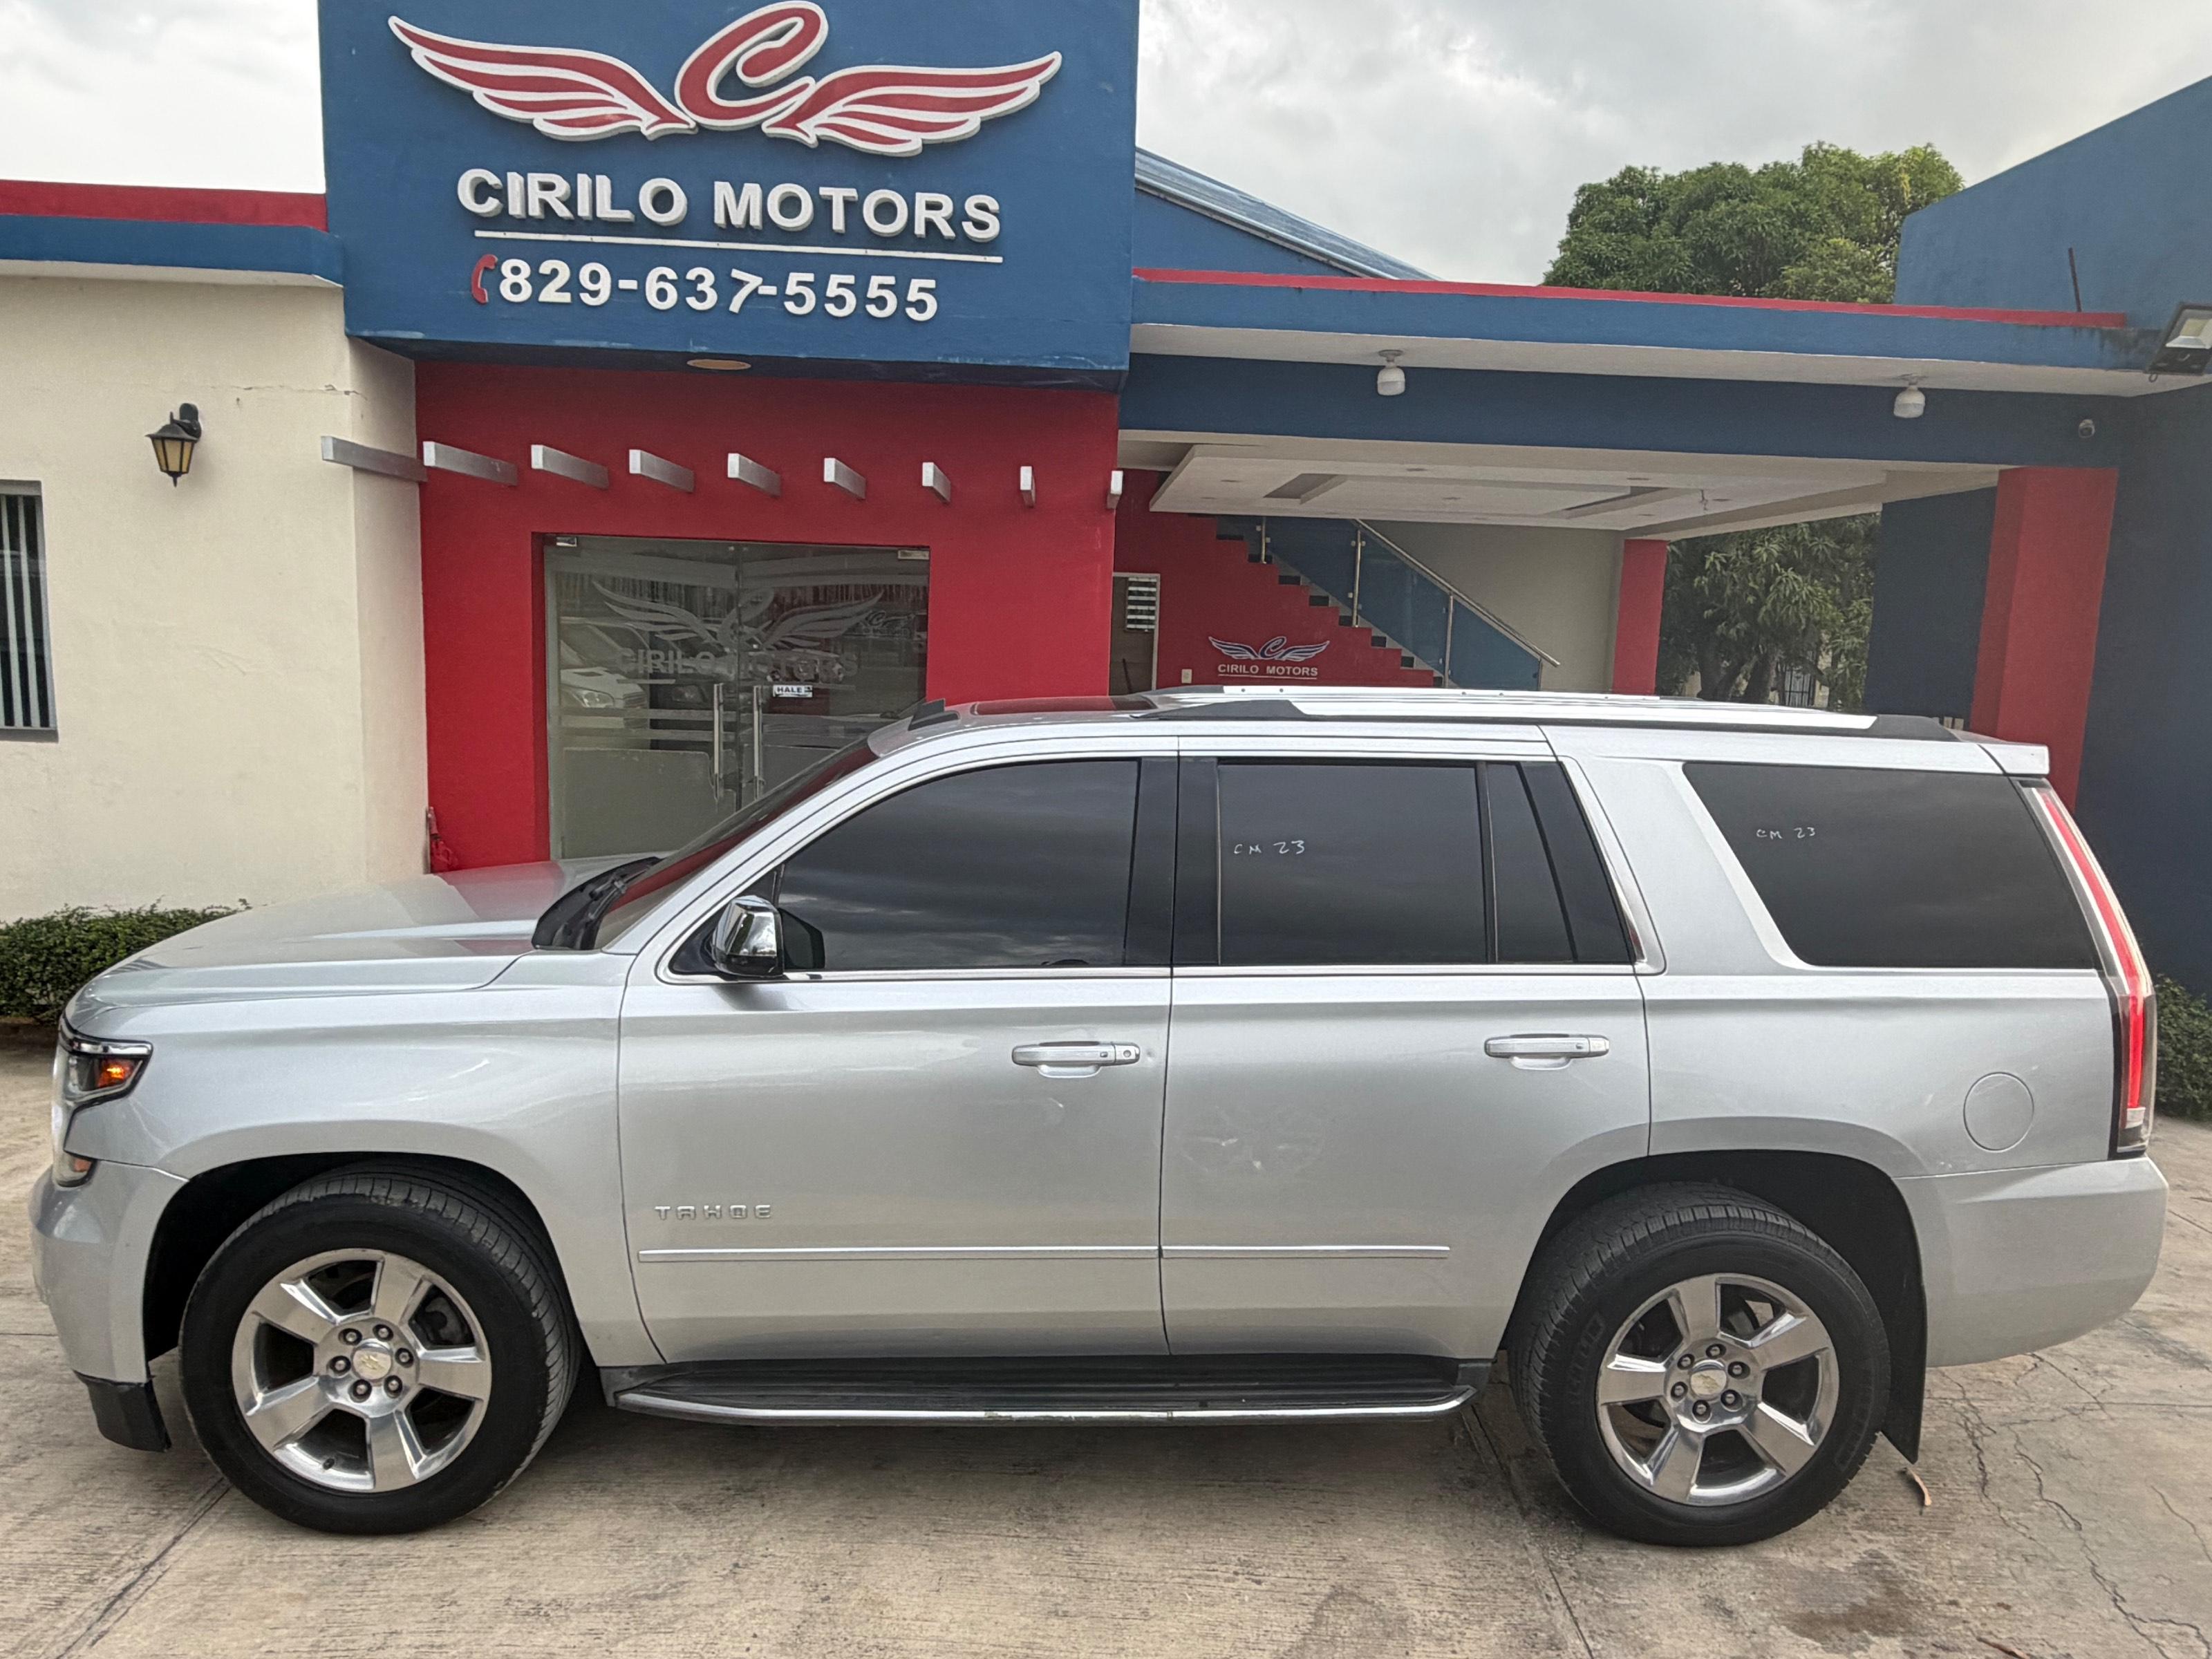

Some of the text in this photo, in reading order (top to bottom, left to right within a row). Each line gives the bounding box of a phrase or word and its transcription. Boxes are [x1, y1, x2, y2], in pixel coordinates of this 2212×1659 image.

[457, 169, 1000, 242] CIRILO MOTORS
[499, 258, 937, 321] 829-637-5555
[1217, 664, 1318, 677] CIRILO MOTORS
[1794, 827, 1816, 838] 23
[1273, 840, 1305, 854] 23
[654, 1204, 772, 1220] TAHOE
